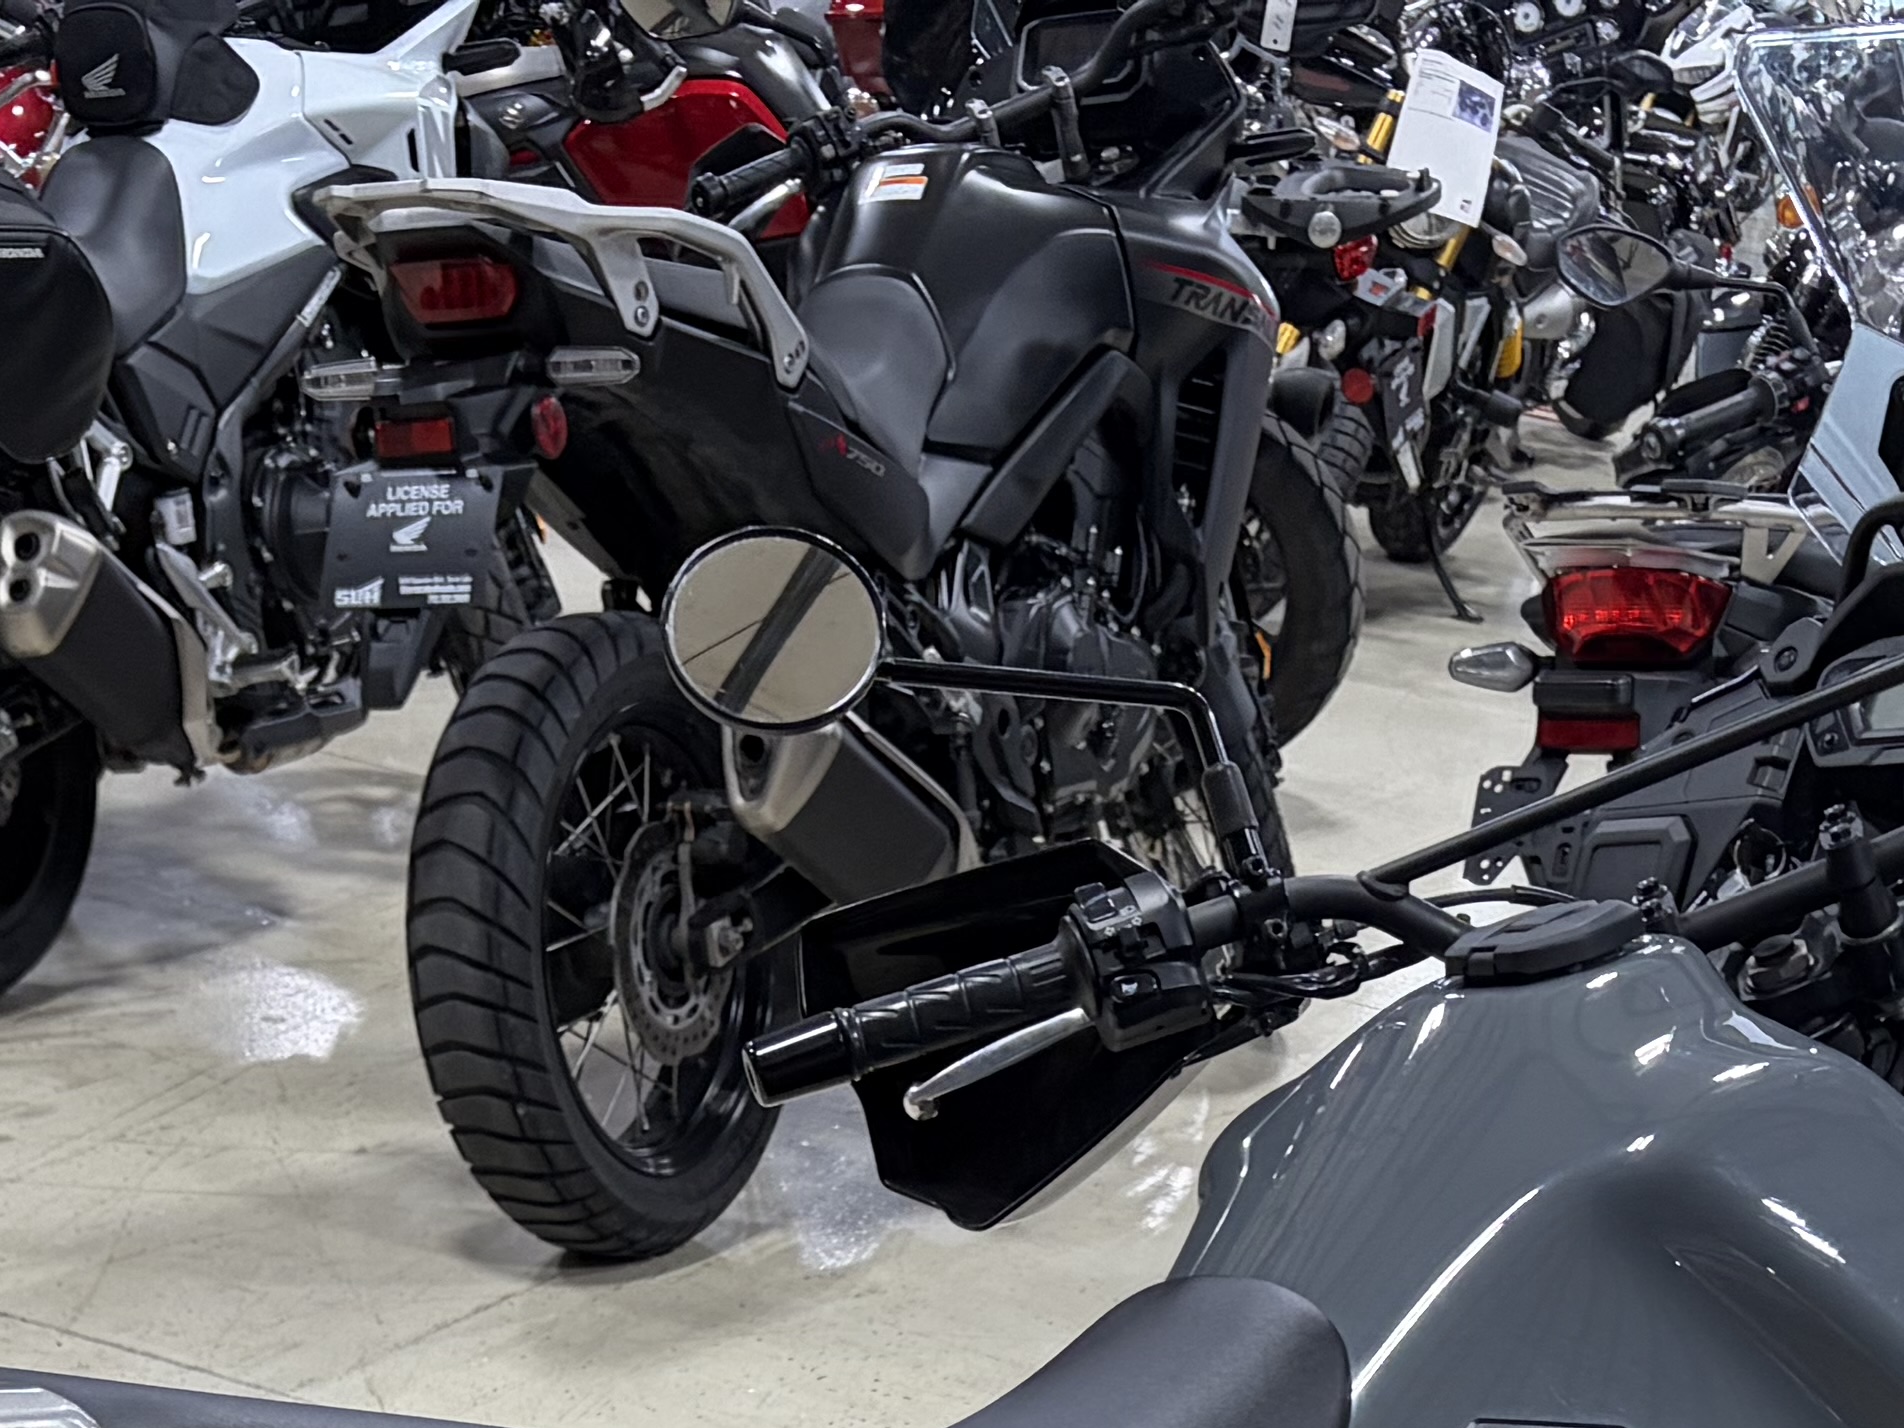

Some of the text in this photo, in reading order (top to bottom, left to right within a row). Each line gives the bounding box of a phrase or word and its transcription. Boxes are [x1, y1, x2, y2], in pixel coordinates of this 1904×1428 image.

[386, 484, 450, 500] LICENSE
[366, 500, 464, 518] APPLIED FOR
